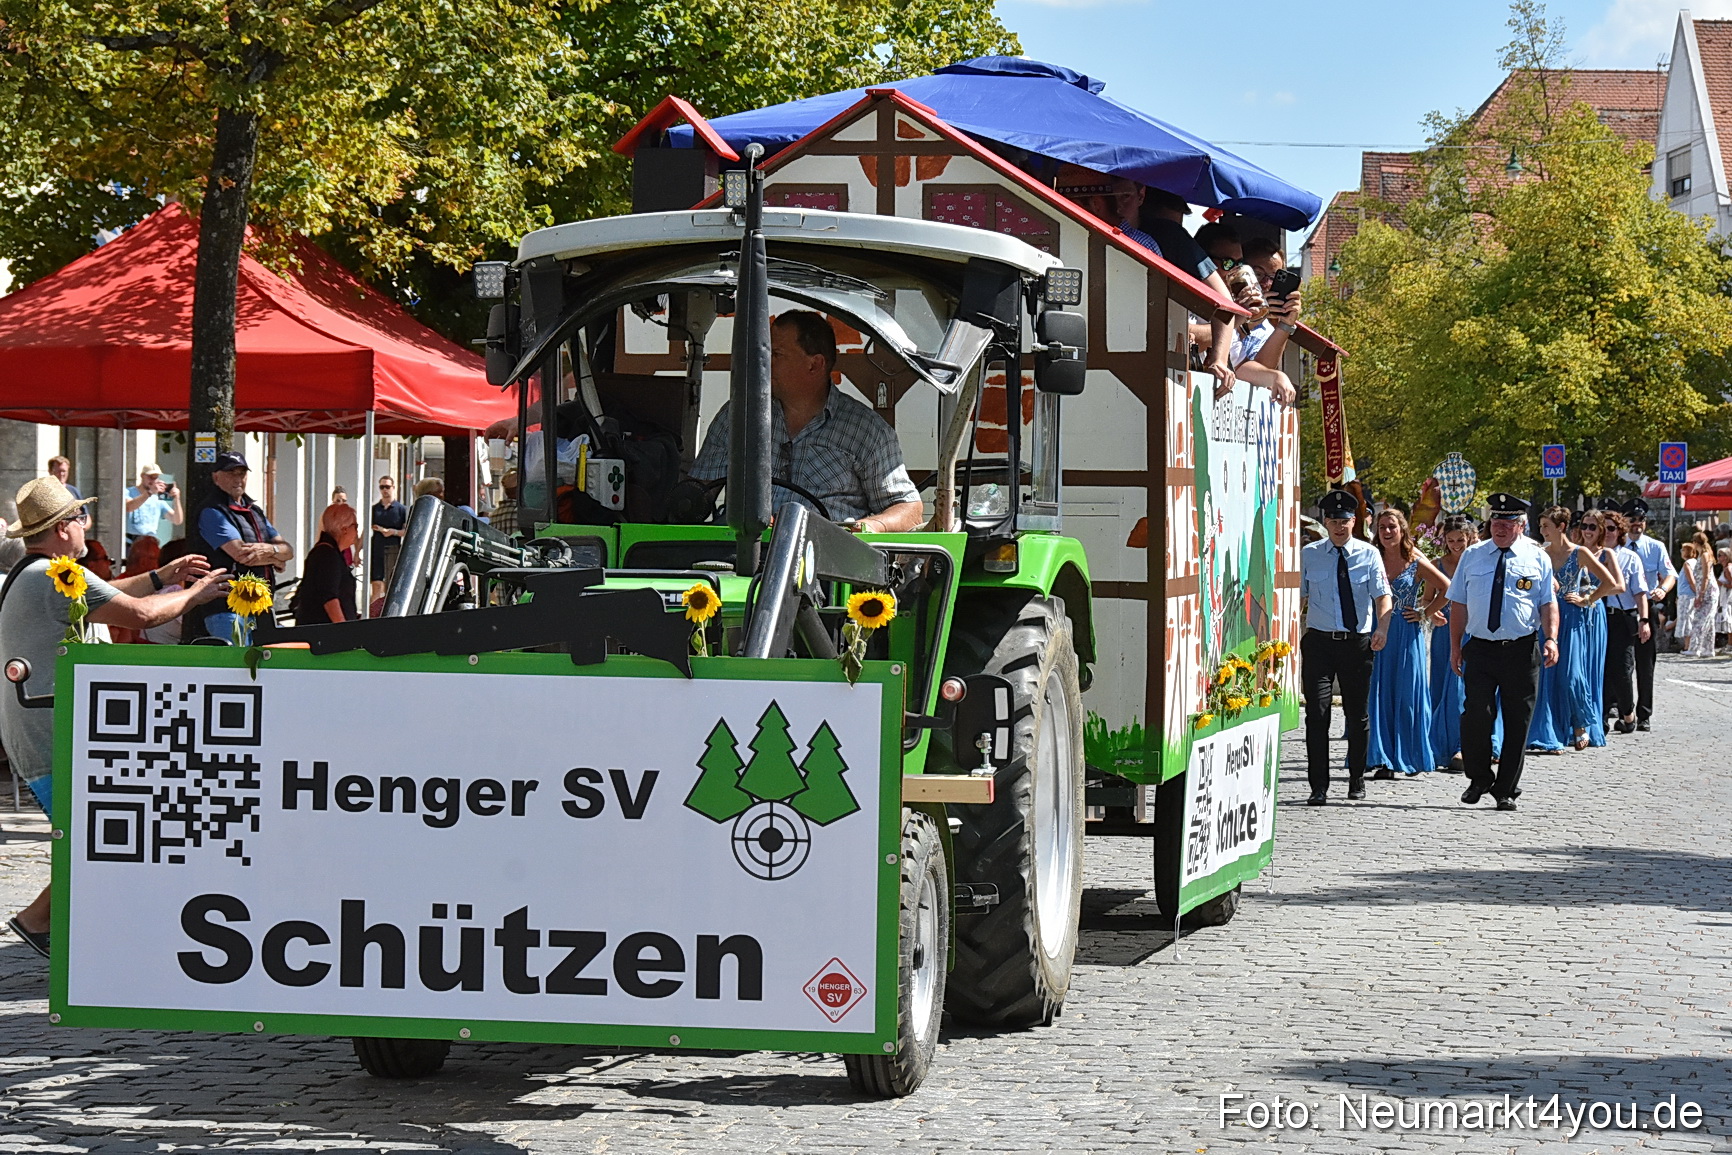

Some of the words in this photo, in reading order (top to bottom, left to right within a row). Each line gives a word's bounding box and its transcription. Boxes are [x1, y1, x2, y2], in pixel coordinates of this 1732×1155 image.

[1545, 467, 1563, 475] TAXI
[1661, 470, 1685, 480] TAXI
[1243, 734, 1255, 767] SV
[282, 760, 540, 829] Henger
[561, 767, 660, 820] SV
[177, 894, 764, 1002] Schützen
[819, 982, 851, 991] HENGER
[853, 987, 862, 995] 63
[826, 992, 843, 1003] SV
[830, 1009, 840, 1017] eV
